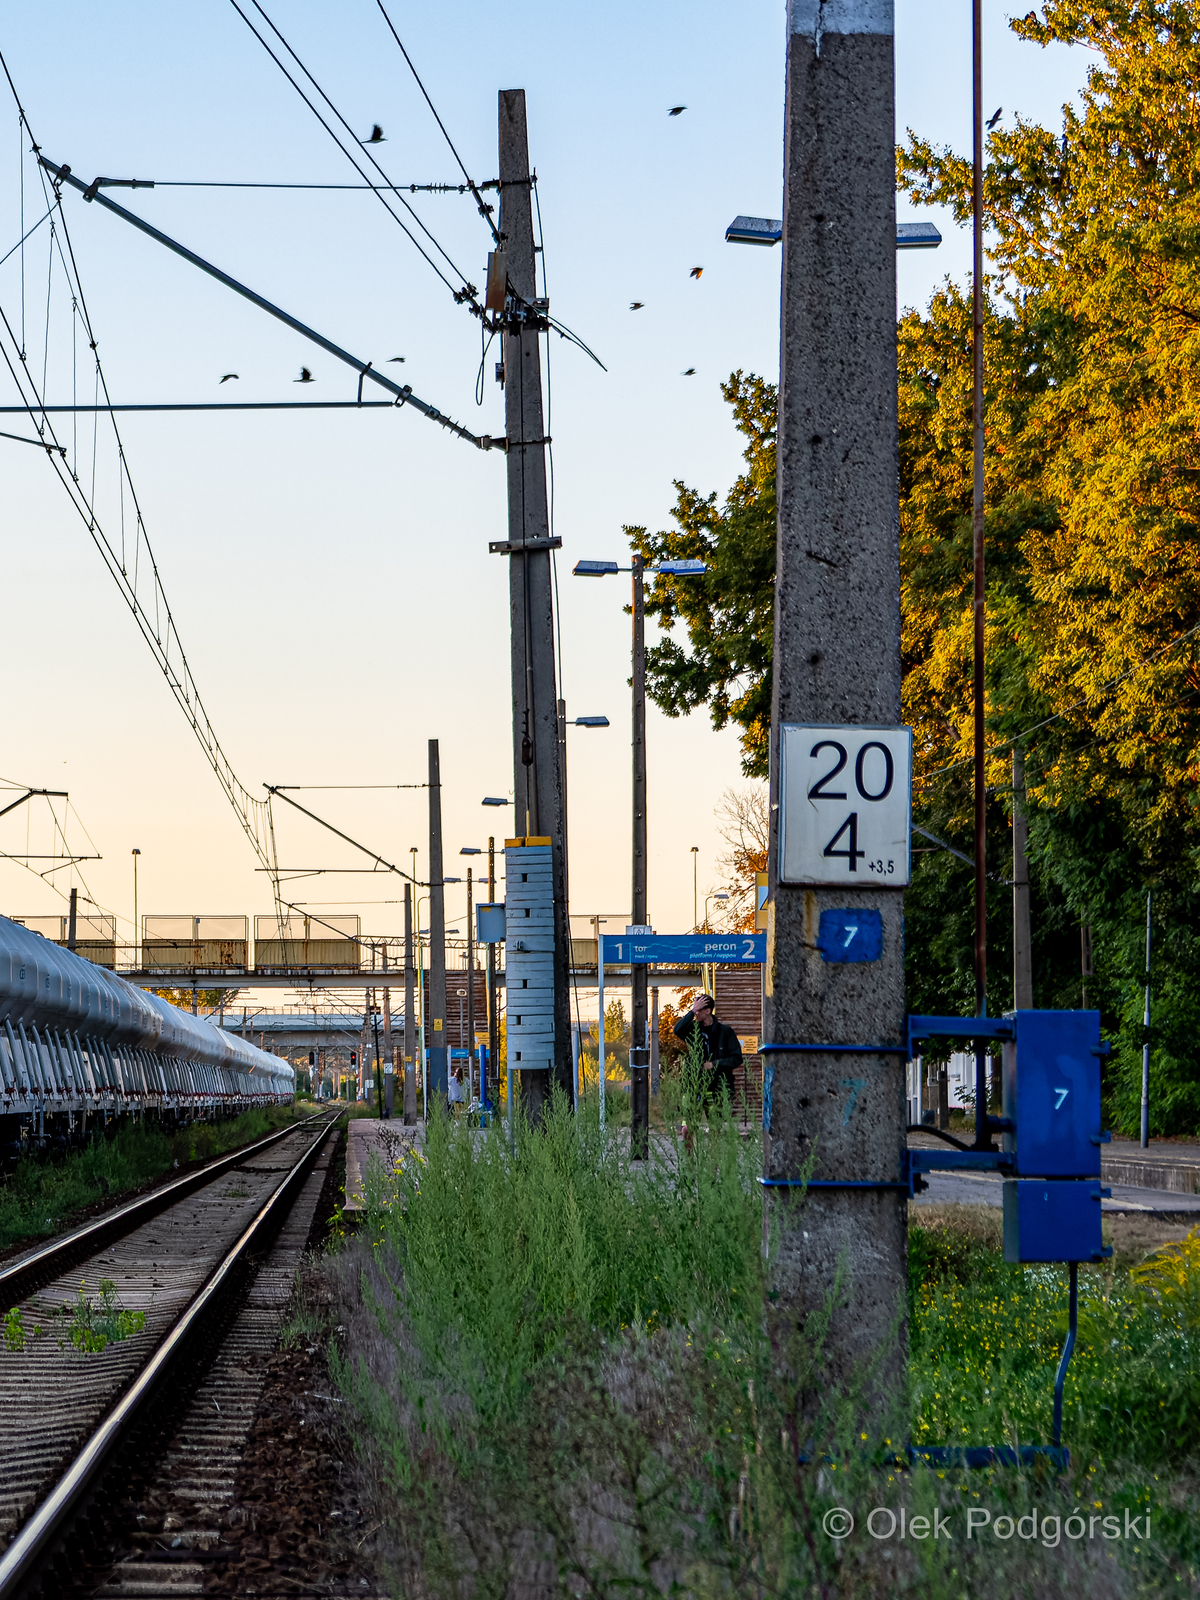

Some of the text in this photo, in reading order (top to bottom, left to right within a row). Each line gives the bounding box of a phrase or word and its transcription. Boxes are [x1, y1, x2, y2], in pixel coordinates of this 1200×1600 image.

[808, 740, 894, 802] 20
[823, 812, 865, 872] 4
[868, 860, 894, 876] +3,5
[705, 942, 737, 953] peron
[844, 926, 858, 948] 7
[615, 943, 623, 960] 1
[741, 939, 756, 959] 2
[1054, 1087, 1069, 1110] 7
